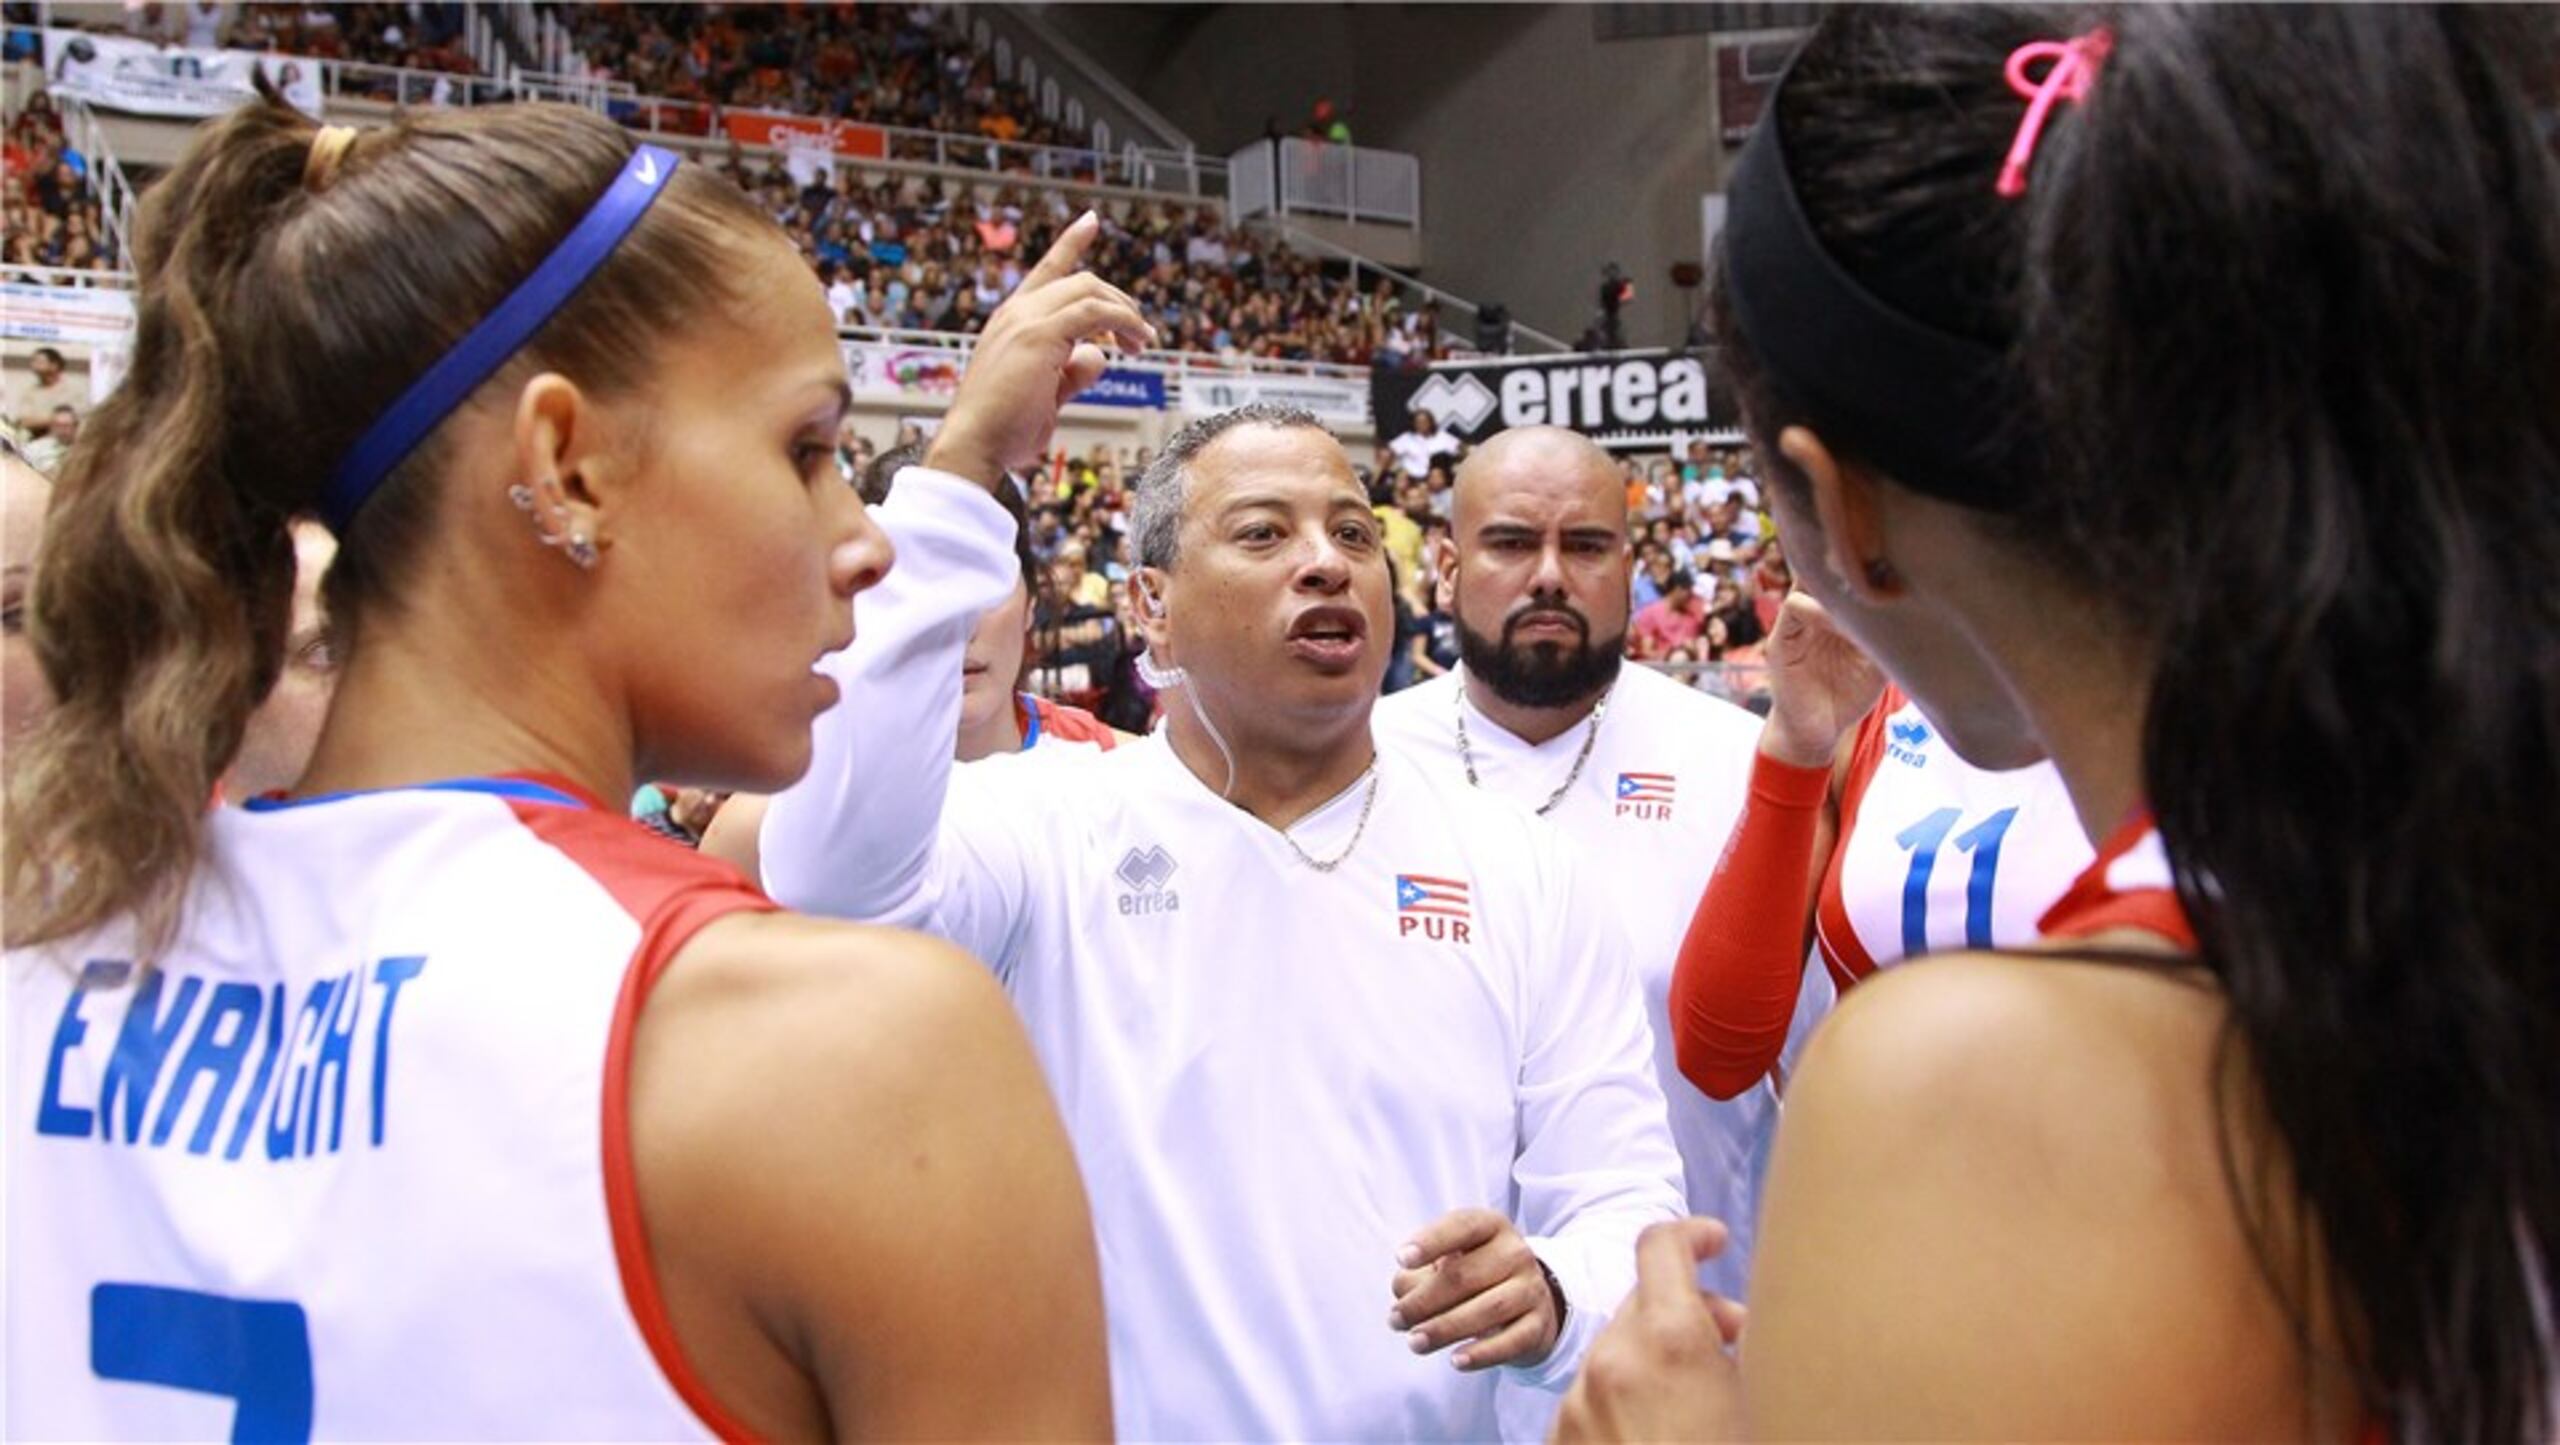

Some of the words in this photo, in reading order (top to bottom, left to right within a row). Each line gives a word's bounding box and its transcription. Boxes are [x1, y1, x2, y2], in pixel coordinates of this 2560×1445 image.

[1502, 358, 1707, 426] errea
[1616, 804, 1672, 821] PUR
[1118, 890, 1179, 915] errea
[1895, 806, 2019, 957] 11
[1400, 916, 1469, 944] PUR
[36, 956, 427, 1161] ENRIGHT
